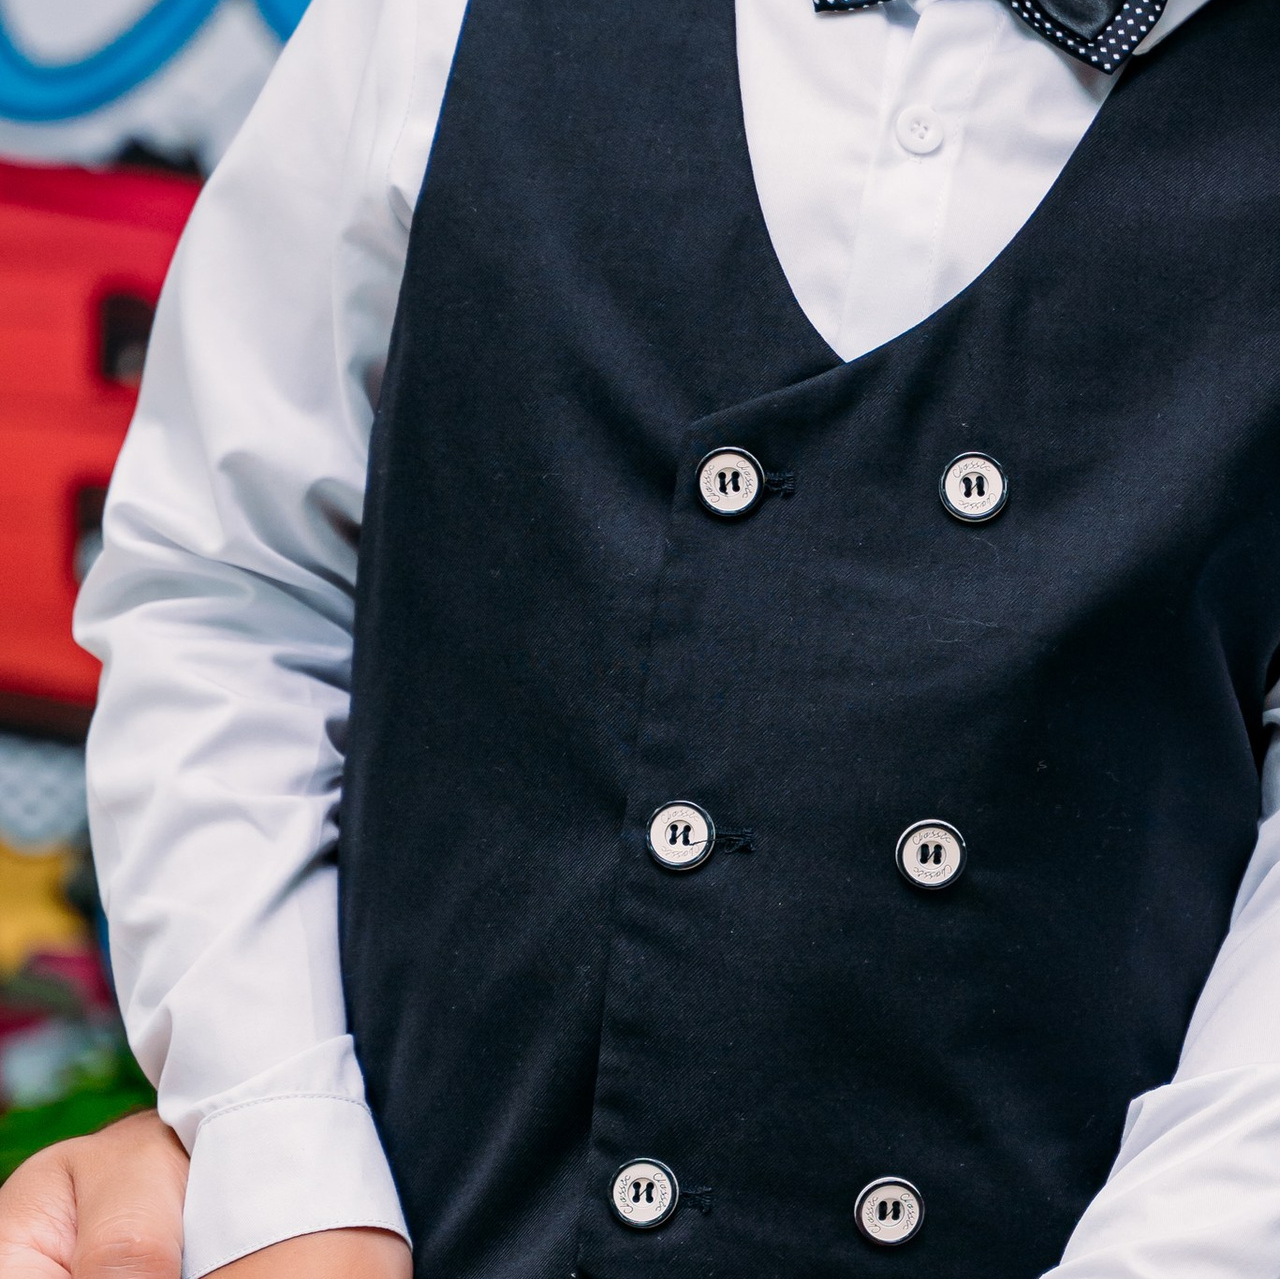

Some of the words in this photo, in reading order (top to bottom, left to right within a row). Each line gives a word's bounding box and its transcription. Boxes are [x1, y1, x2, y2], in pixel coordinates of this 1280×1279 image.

[705, 464, 720, 503] Classic
[736, 460, 754, 499] Classic
[952, 460, 991, 478] Classic
[660, 808, 699, 824] Classic
[912, 830, 951, 845] Classic
[619, 1175, 634, 1214] Classic
[653, 1172, 667, 1212] Classic
[900, 1193, 915, 1230] Classic
